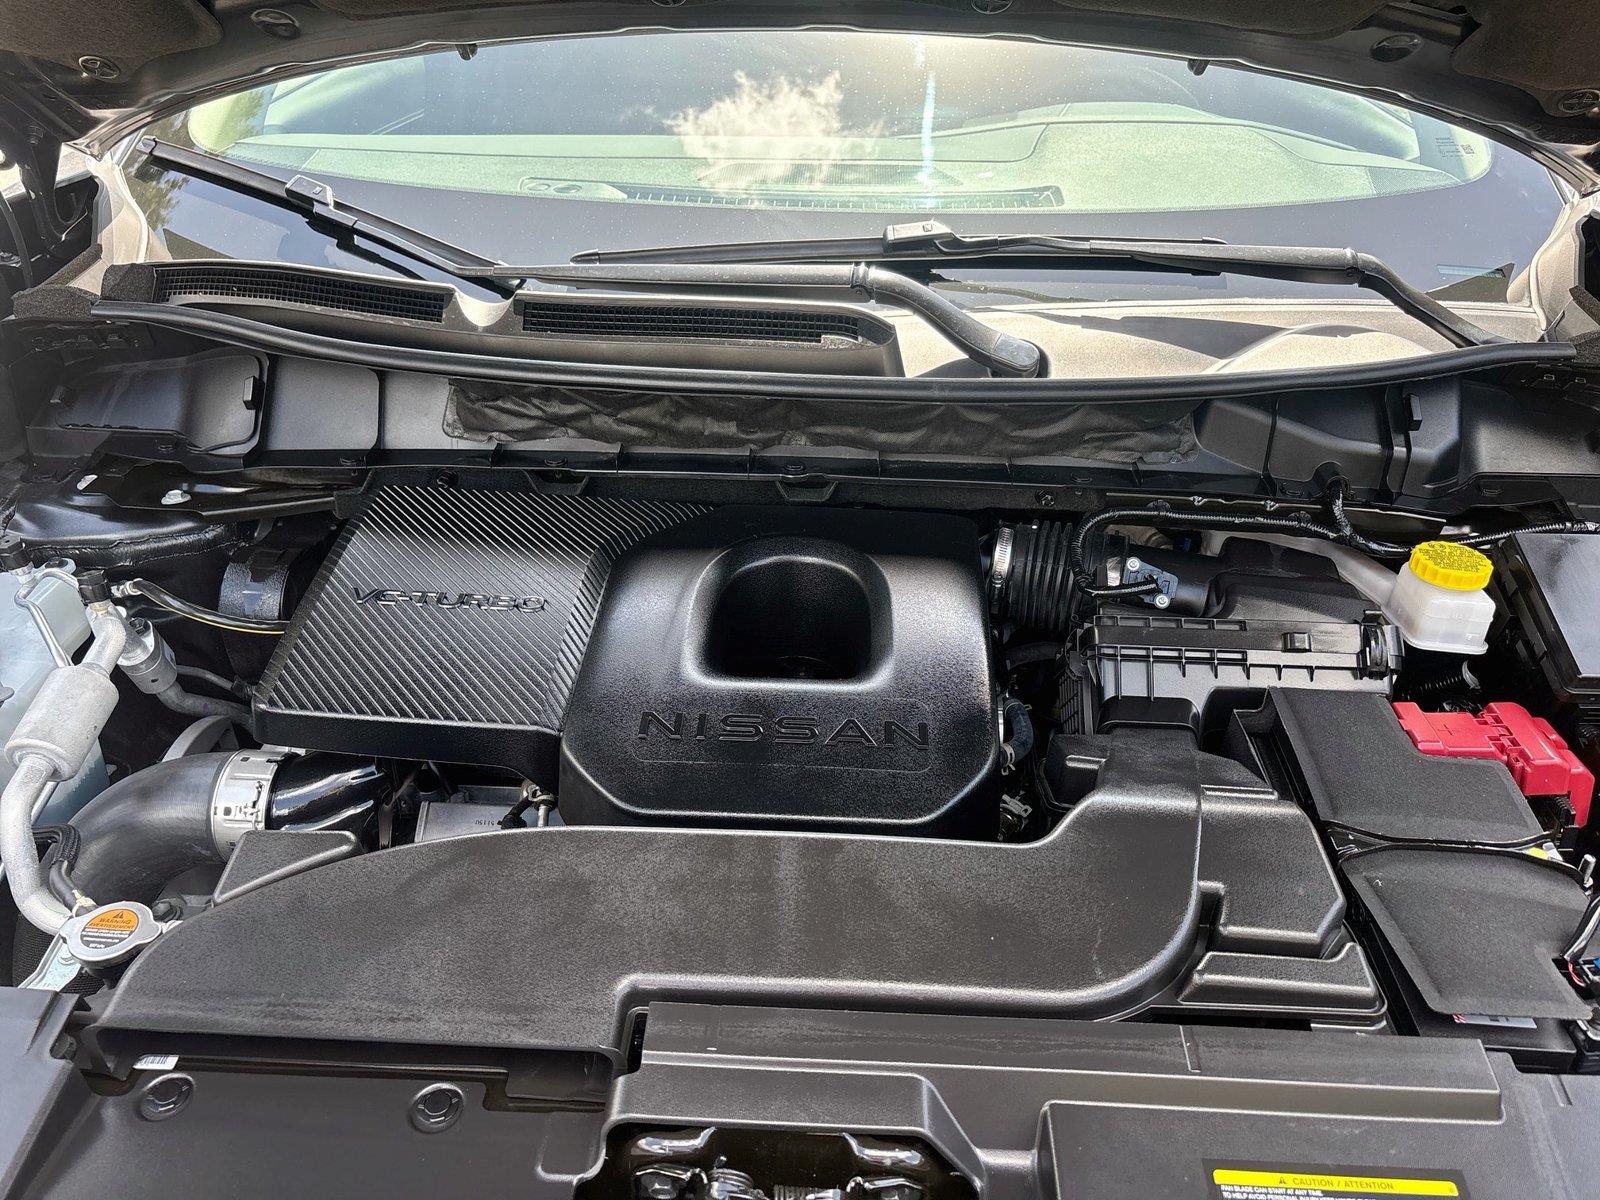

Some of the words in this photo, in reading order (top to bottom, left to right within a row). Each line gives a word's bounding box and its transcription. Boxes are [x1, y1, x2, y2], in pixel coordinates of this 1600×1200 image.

[354, 587, 545, 614] VC-TURBO
[638, 711, 929, 749] NISSAN
[1292, 1177, 1334, 1187] CAUTION
[1344, 1180, 1394, 1190] ATTENTION
